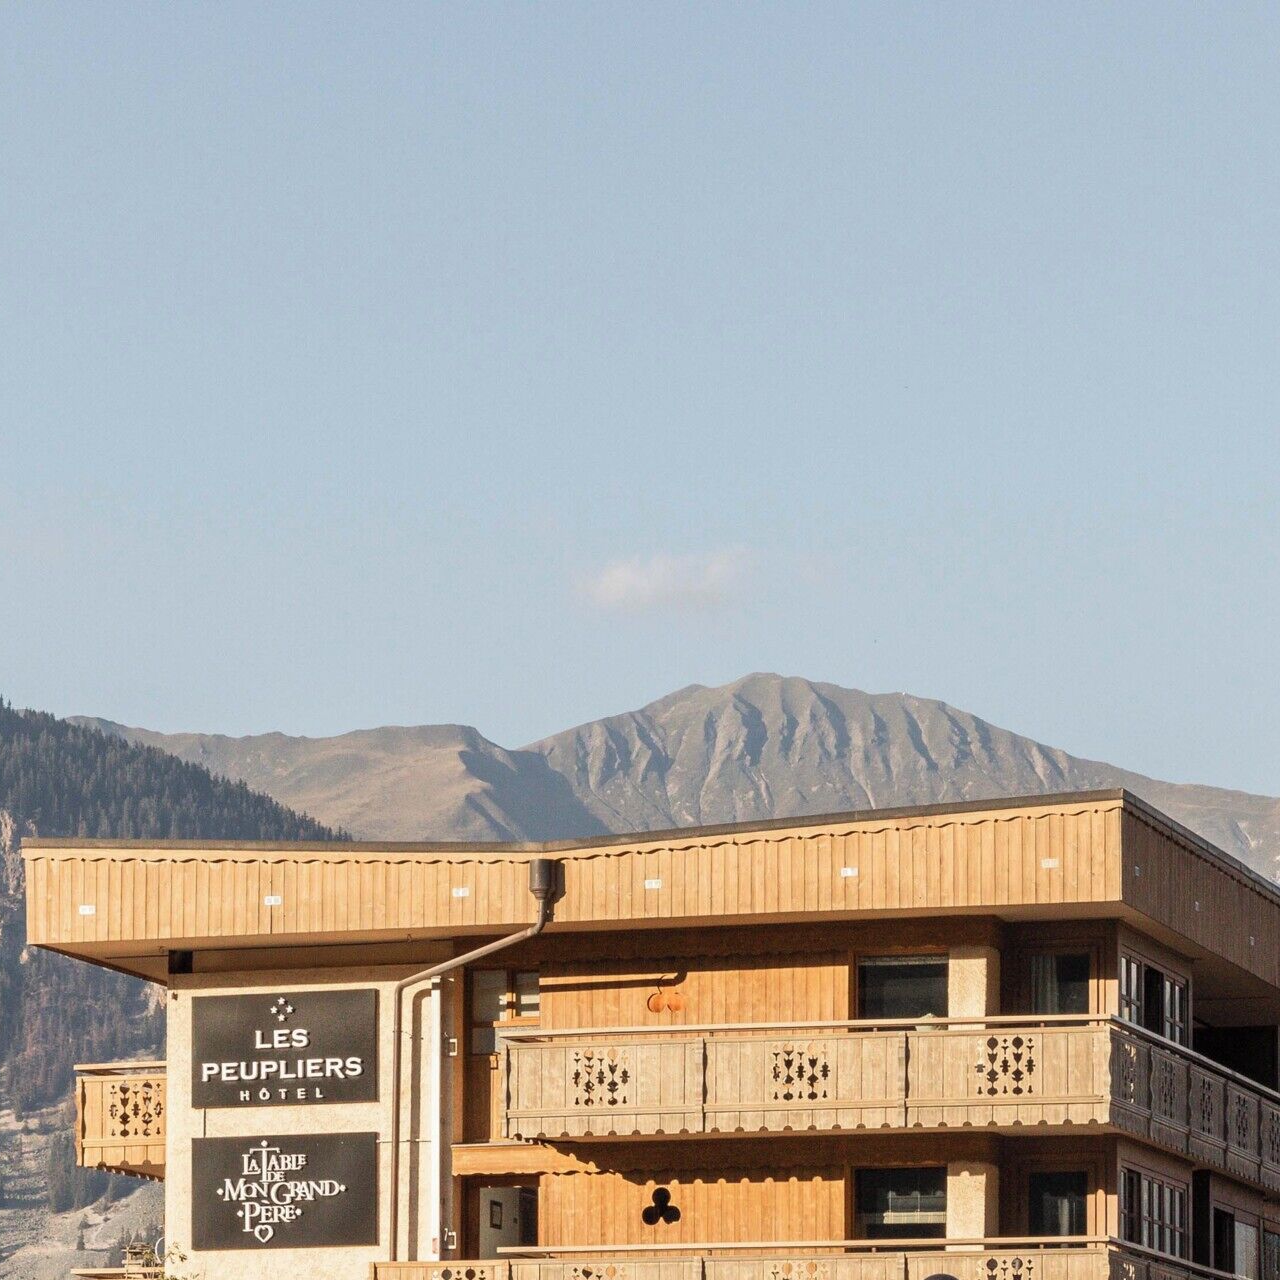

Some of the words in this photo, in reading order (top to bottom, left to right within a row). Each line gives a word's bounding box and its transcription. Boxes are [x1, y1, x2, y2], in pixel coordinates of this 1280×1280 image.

[255, 1028, 309, 1049] LES
[201, 1057, 363, 1082] PEUPLIERS
[240, 1087, 324, 1101] HÔTEL
[270, 1180, 340, 1205] GRAND
